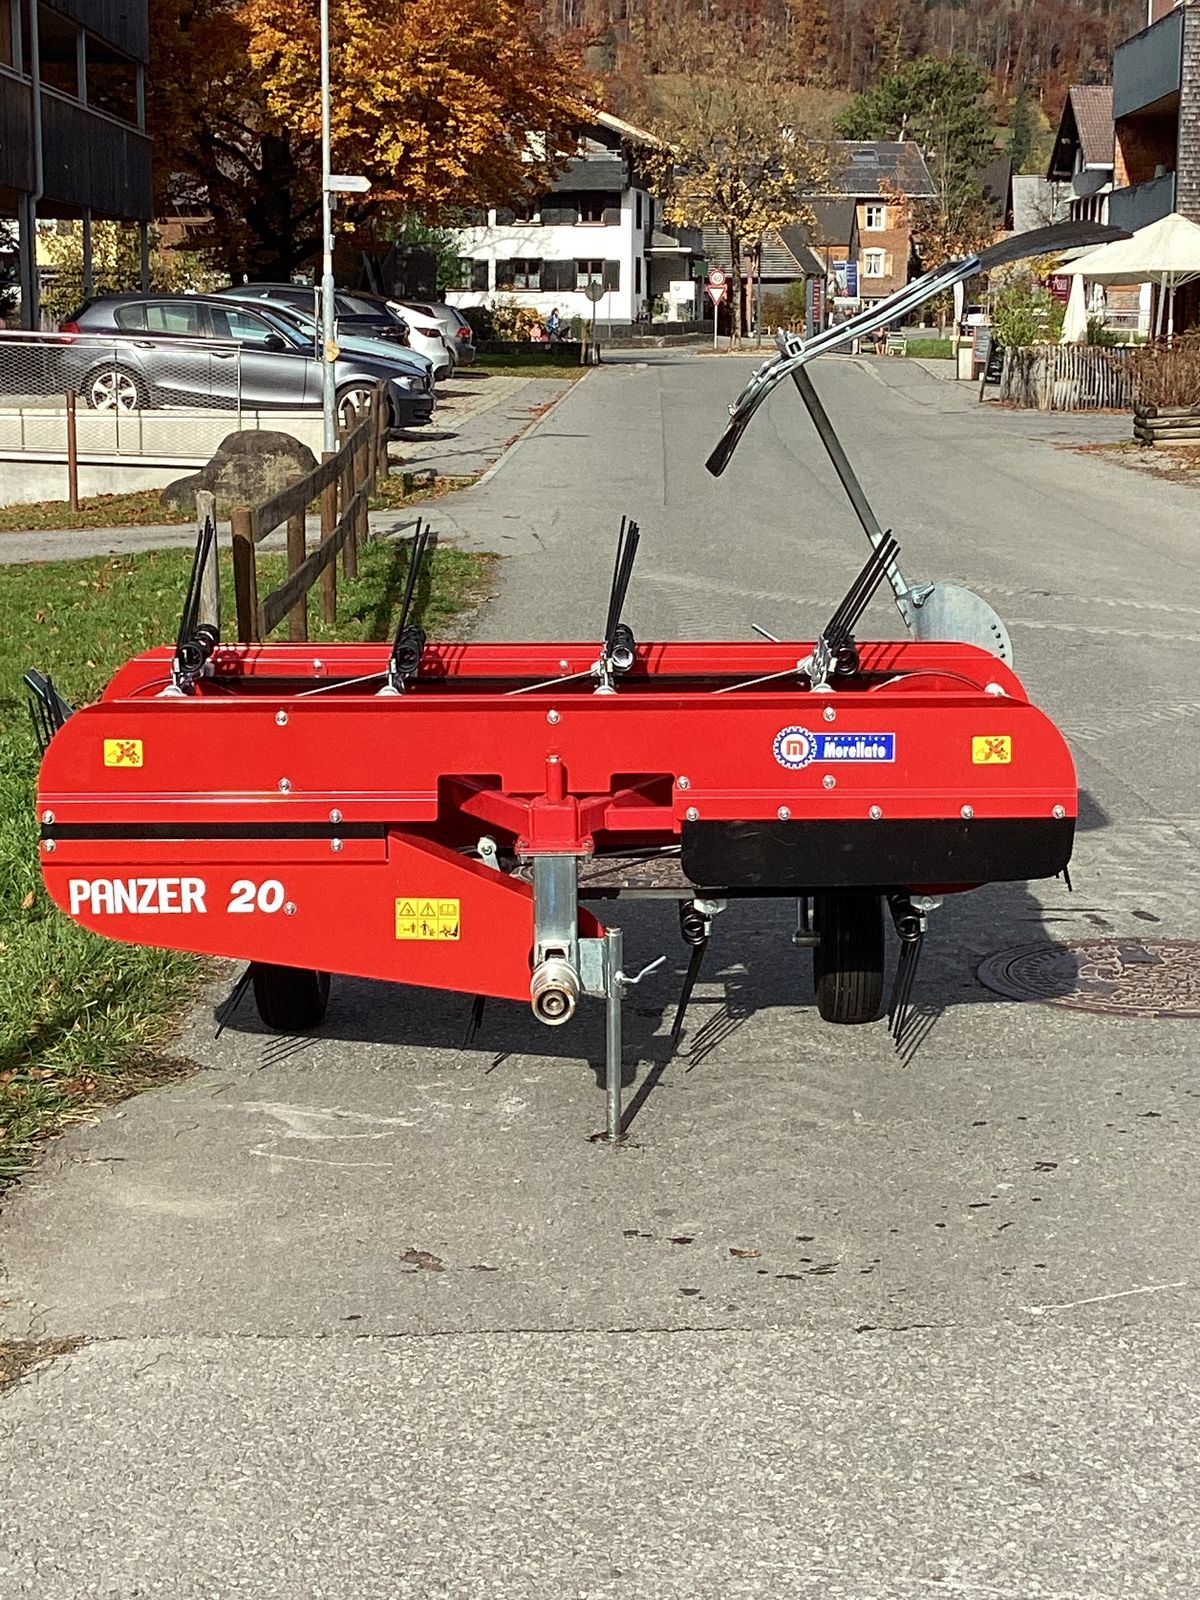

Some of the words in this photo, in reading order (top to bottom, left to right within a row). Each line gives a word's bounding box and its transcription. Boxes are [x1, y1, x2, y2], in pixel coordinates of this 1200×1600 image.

[823, 742, 886, 758] Morellato
[69, 877, 207, 914] PANZER
[227, 879, 285, 913] 20
